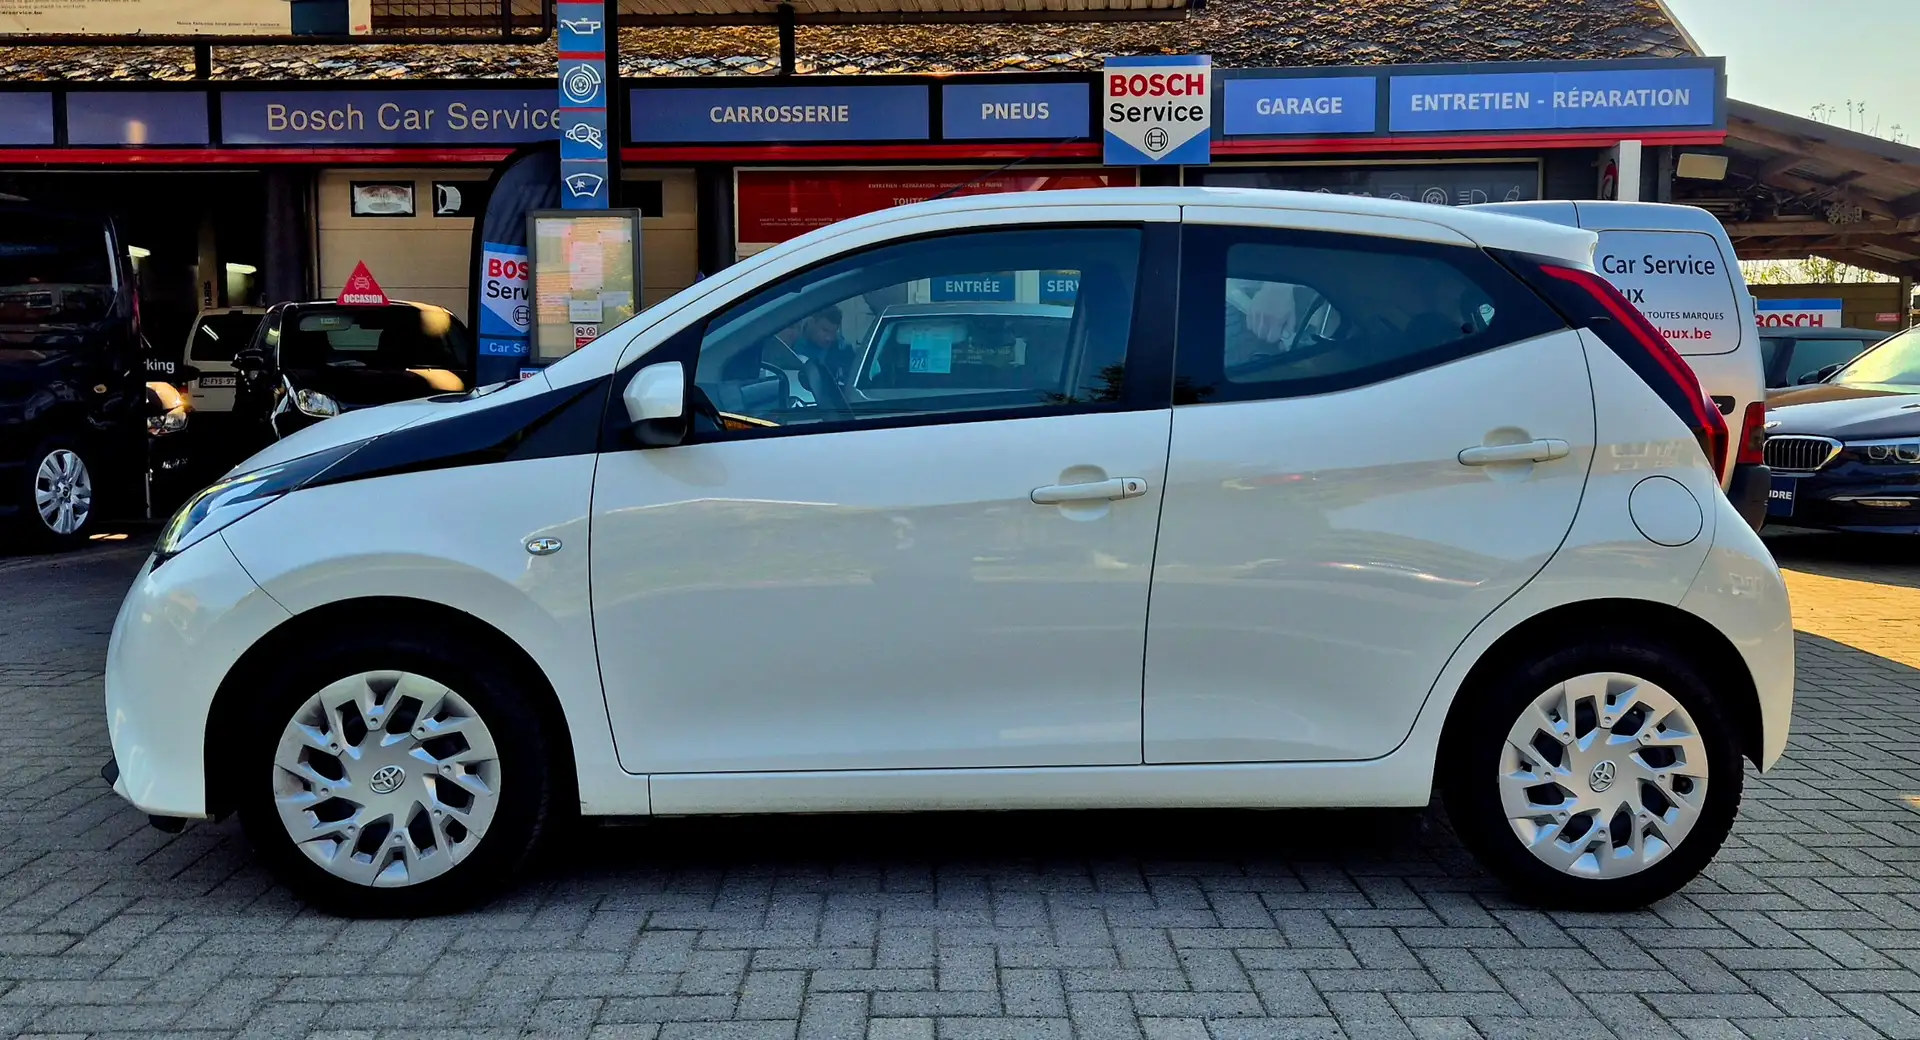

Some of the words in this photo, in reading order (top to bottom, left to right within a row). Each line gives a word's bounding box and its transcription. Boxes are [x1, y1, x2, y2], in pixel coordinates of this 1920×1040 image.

[1110, 73, 1204, 97] BOSCH
[1256, 97, 1343, 115] GARAGE
[1411, 91, 1530, 112] ENTRETIEN
[1552, 86, 1690, 109] RÉPARATION
[267, 103, 364, 131] Bosch
[377, 103, 434, 131] Car
[710, 105, 849, 123] CARROSSERIE
[981, 102, 1050, 120] PNEUS
[1109, 100, 1204, 122] Service
[1602, 255, 1636, 274] Car
[1643, 254, 1716, 275] Service
[945, 278, 1000, 293] ENTRÉE
[343, 294, 383, 304] OCCASION
[1648, 311, 1681, 320] TOUTES
[1682, 311, 1724, 321] MARQUES
[489, 342, 510, 353] Car
[144, 359, 175, 374] king
